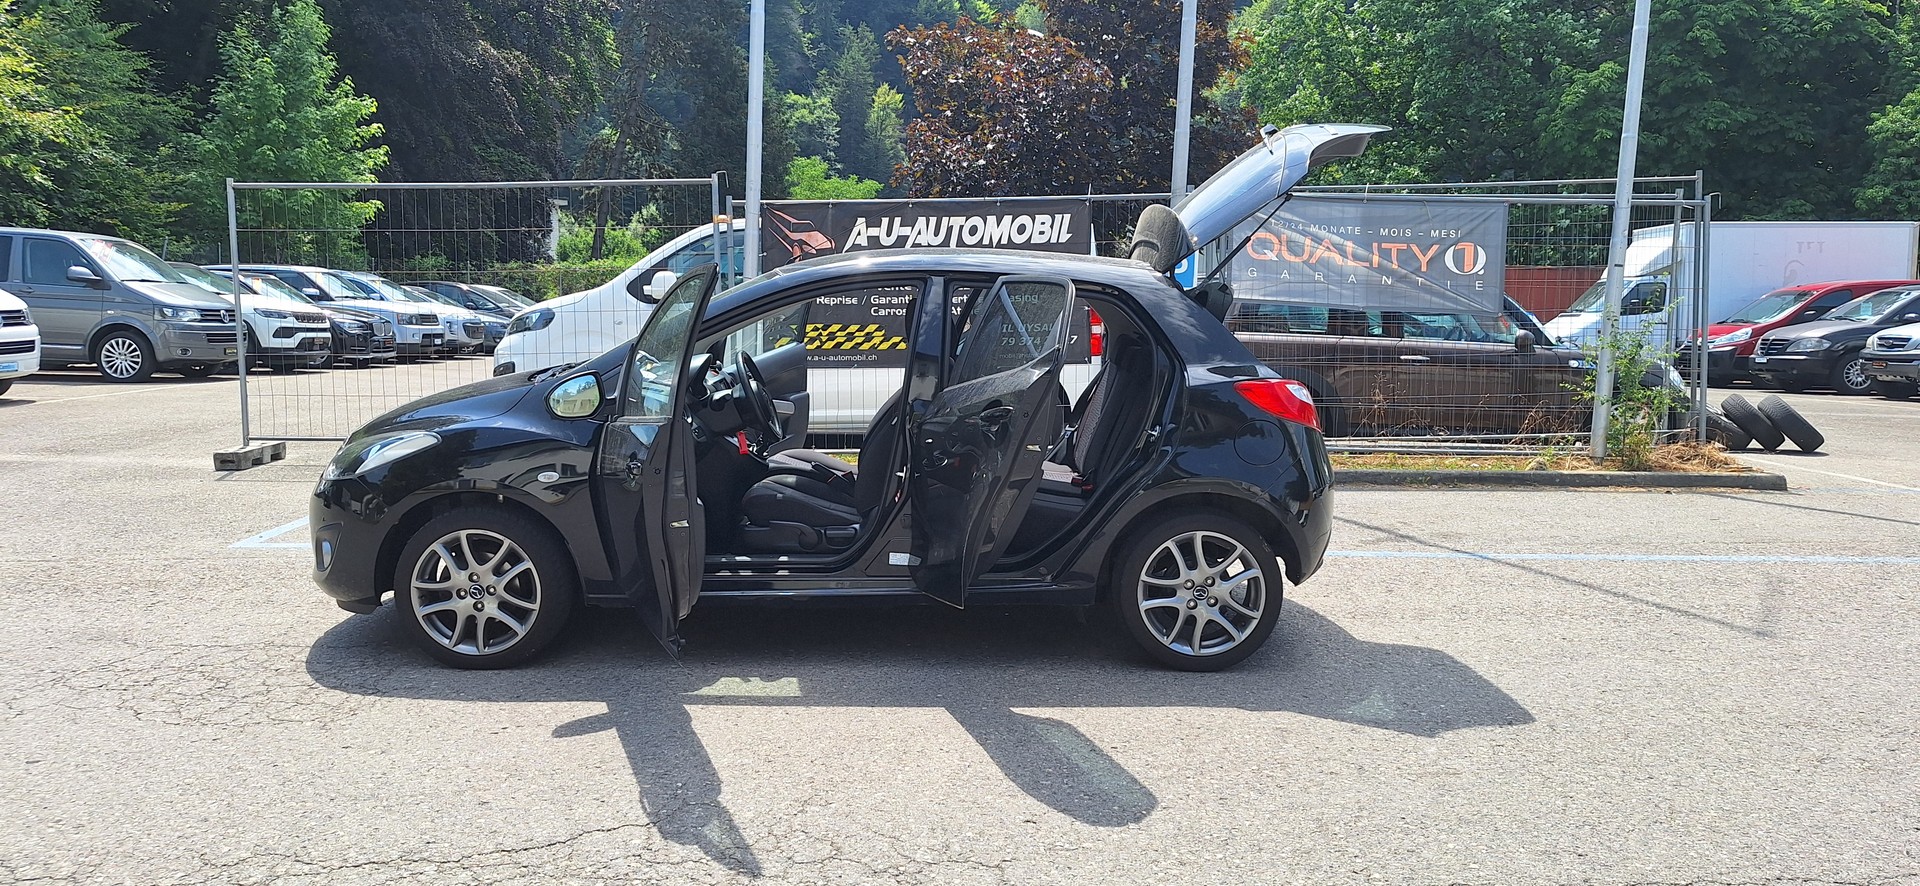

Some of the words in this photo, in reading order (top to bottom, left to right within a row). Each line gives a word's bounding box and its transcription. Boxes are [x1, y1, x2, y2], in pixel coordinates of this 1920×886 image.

[842, 213, 1072, 253] A-U-AUTOMOBIL
[1310, 224, 1361, 235] MONATE
[1379, 227, 1412, 237] MOIS
[1430, 229, 1461, 238] MESI
[1247, 232, 1441, 272] QUALITY
[1247, 267, 1485, 291] GARANTIE
[816, 295, 858, 306] Reprise
